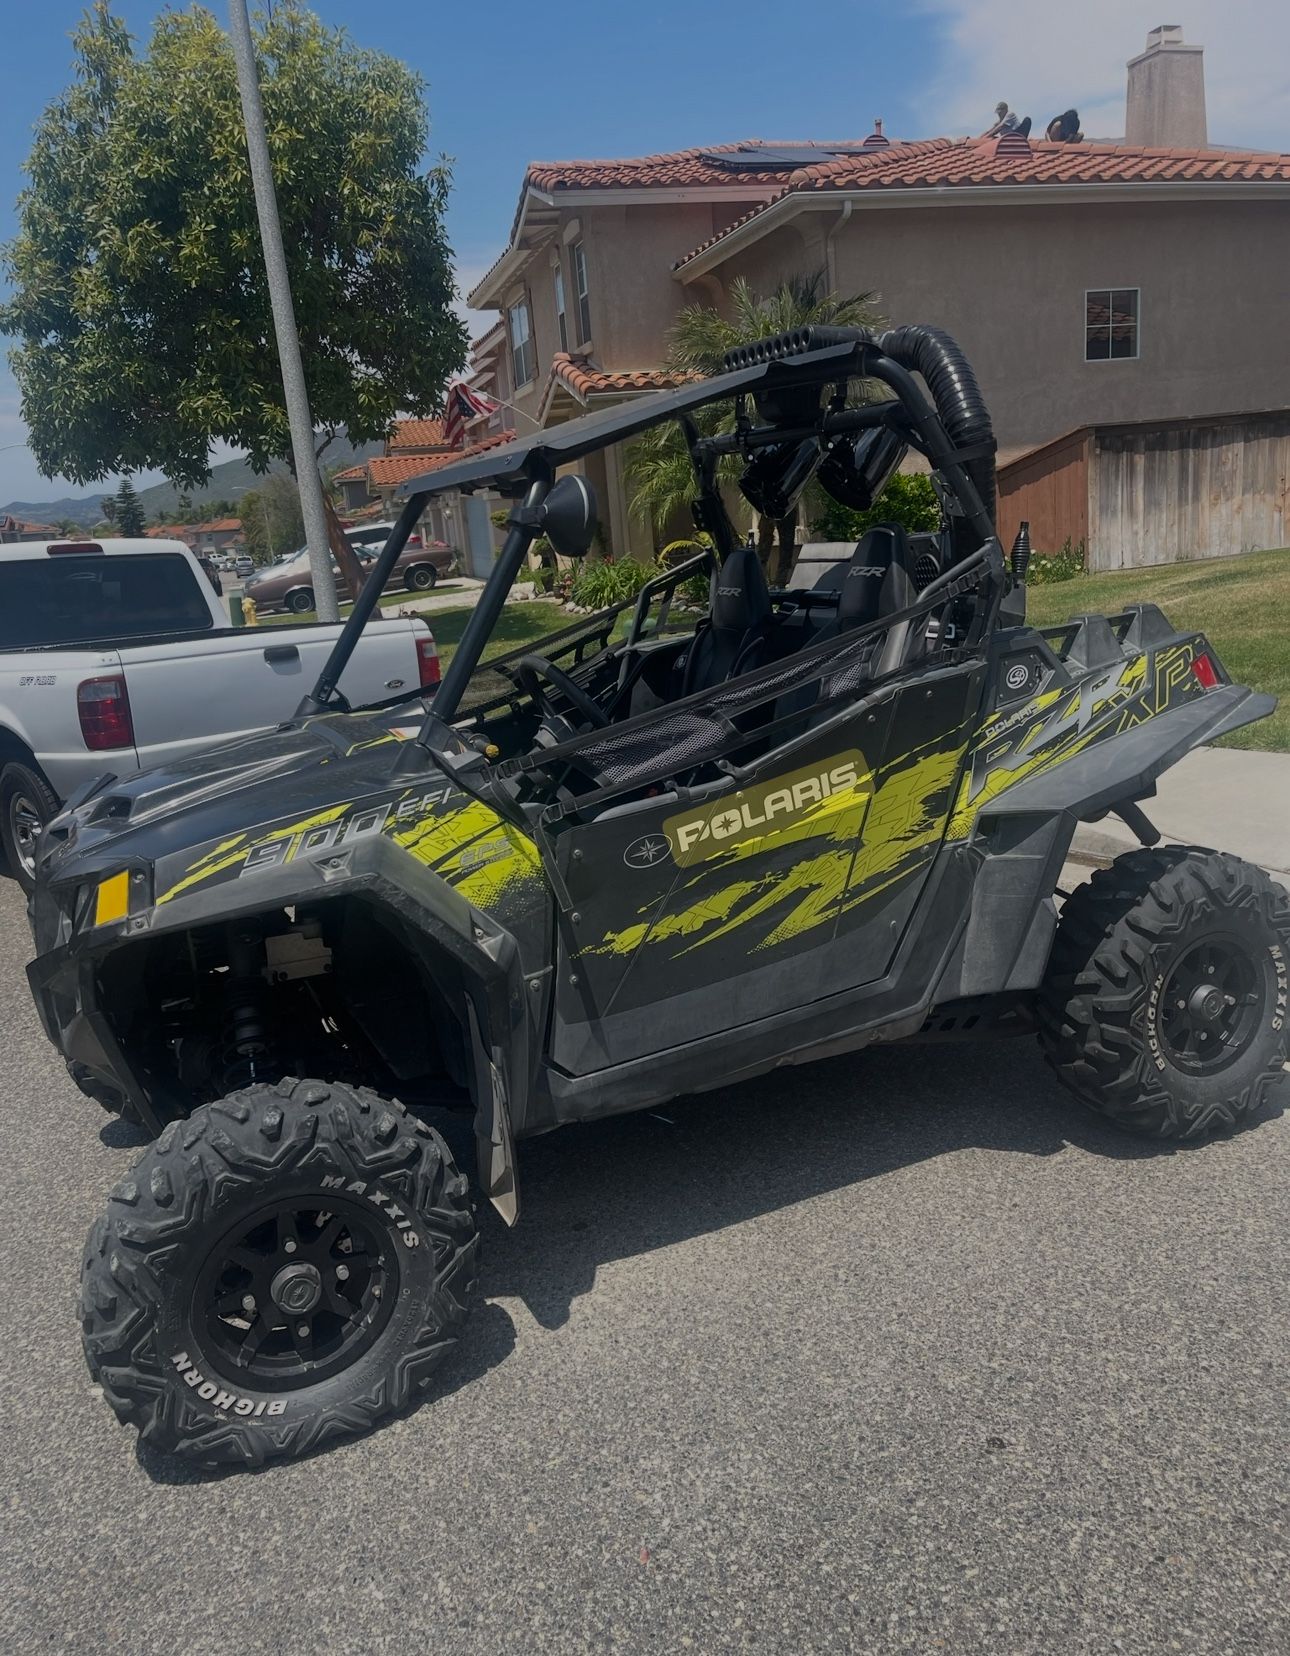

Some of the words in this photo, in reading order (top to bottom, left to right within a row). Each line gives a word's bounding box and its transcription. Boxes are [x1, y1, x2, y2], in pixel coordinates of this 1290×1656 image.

[847, 565, 886, 579] RZR
[239, 802, 392, 877] 900
[396, 787, 452, 818] EFI
[676, 762, 858, 853] POLARIS
[1147, 974, 1166, 1071] BIGHORN
[1269, 945, 1288, 1031] MAXXIS
[320, 1175, 420, 1248] MAXXIS
[169, 1352, 289, 1417] BIGHORN
